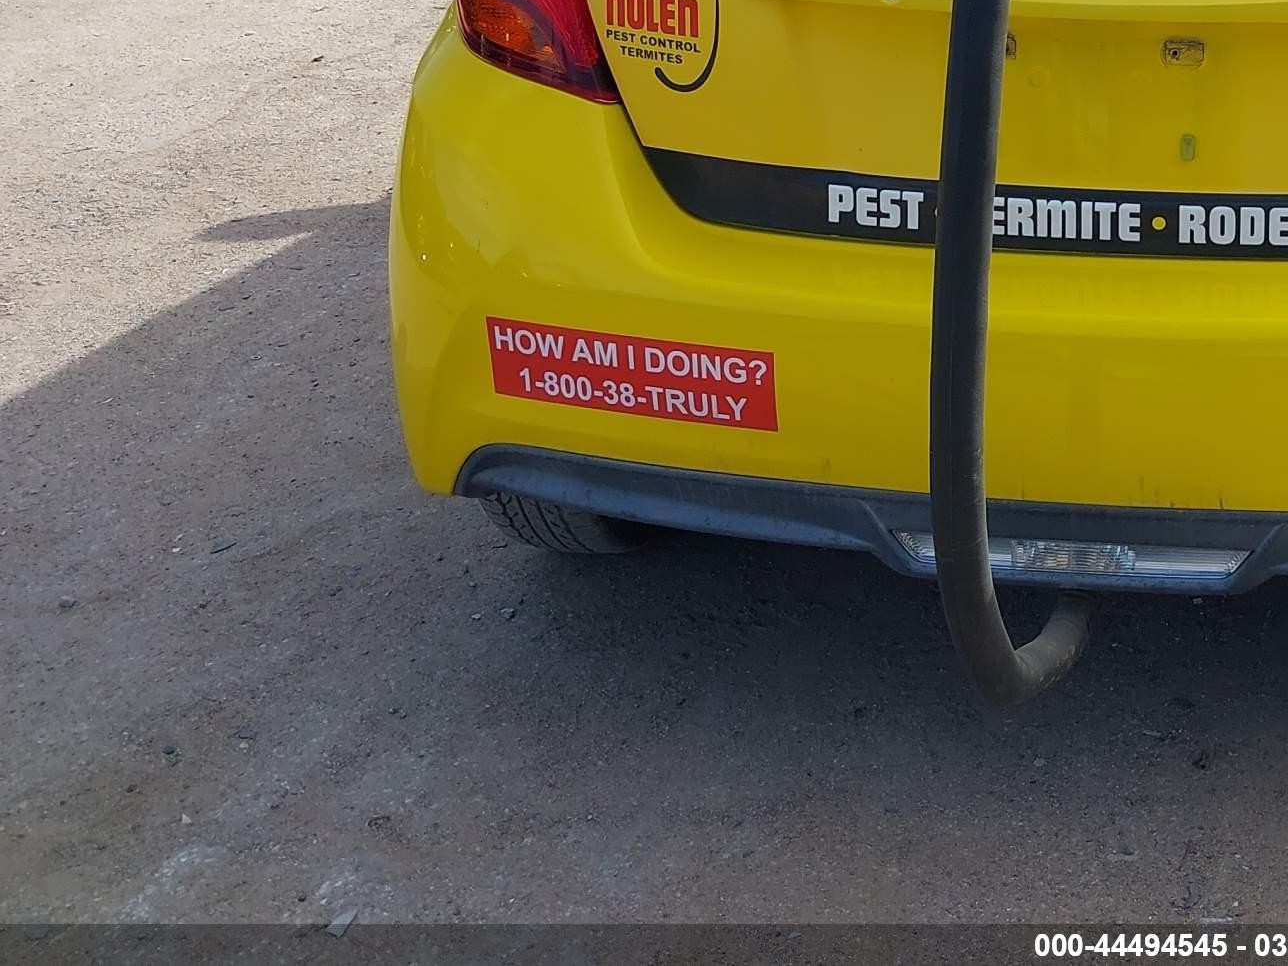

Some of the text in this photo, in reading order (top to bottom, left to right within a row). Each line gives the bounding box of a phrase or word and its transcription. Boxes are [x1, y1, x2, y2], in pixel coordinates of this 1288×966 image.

[606, 29, 701, 53] PEST CONTROL
[620, 45, 683, 64] TERMITES
[828, 184, 924, 230] PEST
[992, 197, 1141, 242] ERMITE
[493, 325, 767, 386] HOW AM I DOING?
[519, 367, 747, 421] 1-800-38-TRULY
